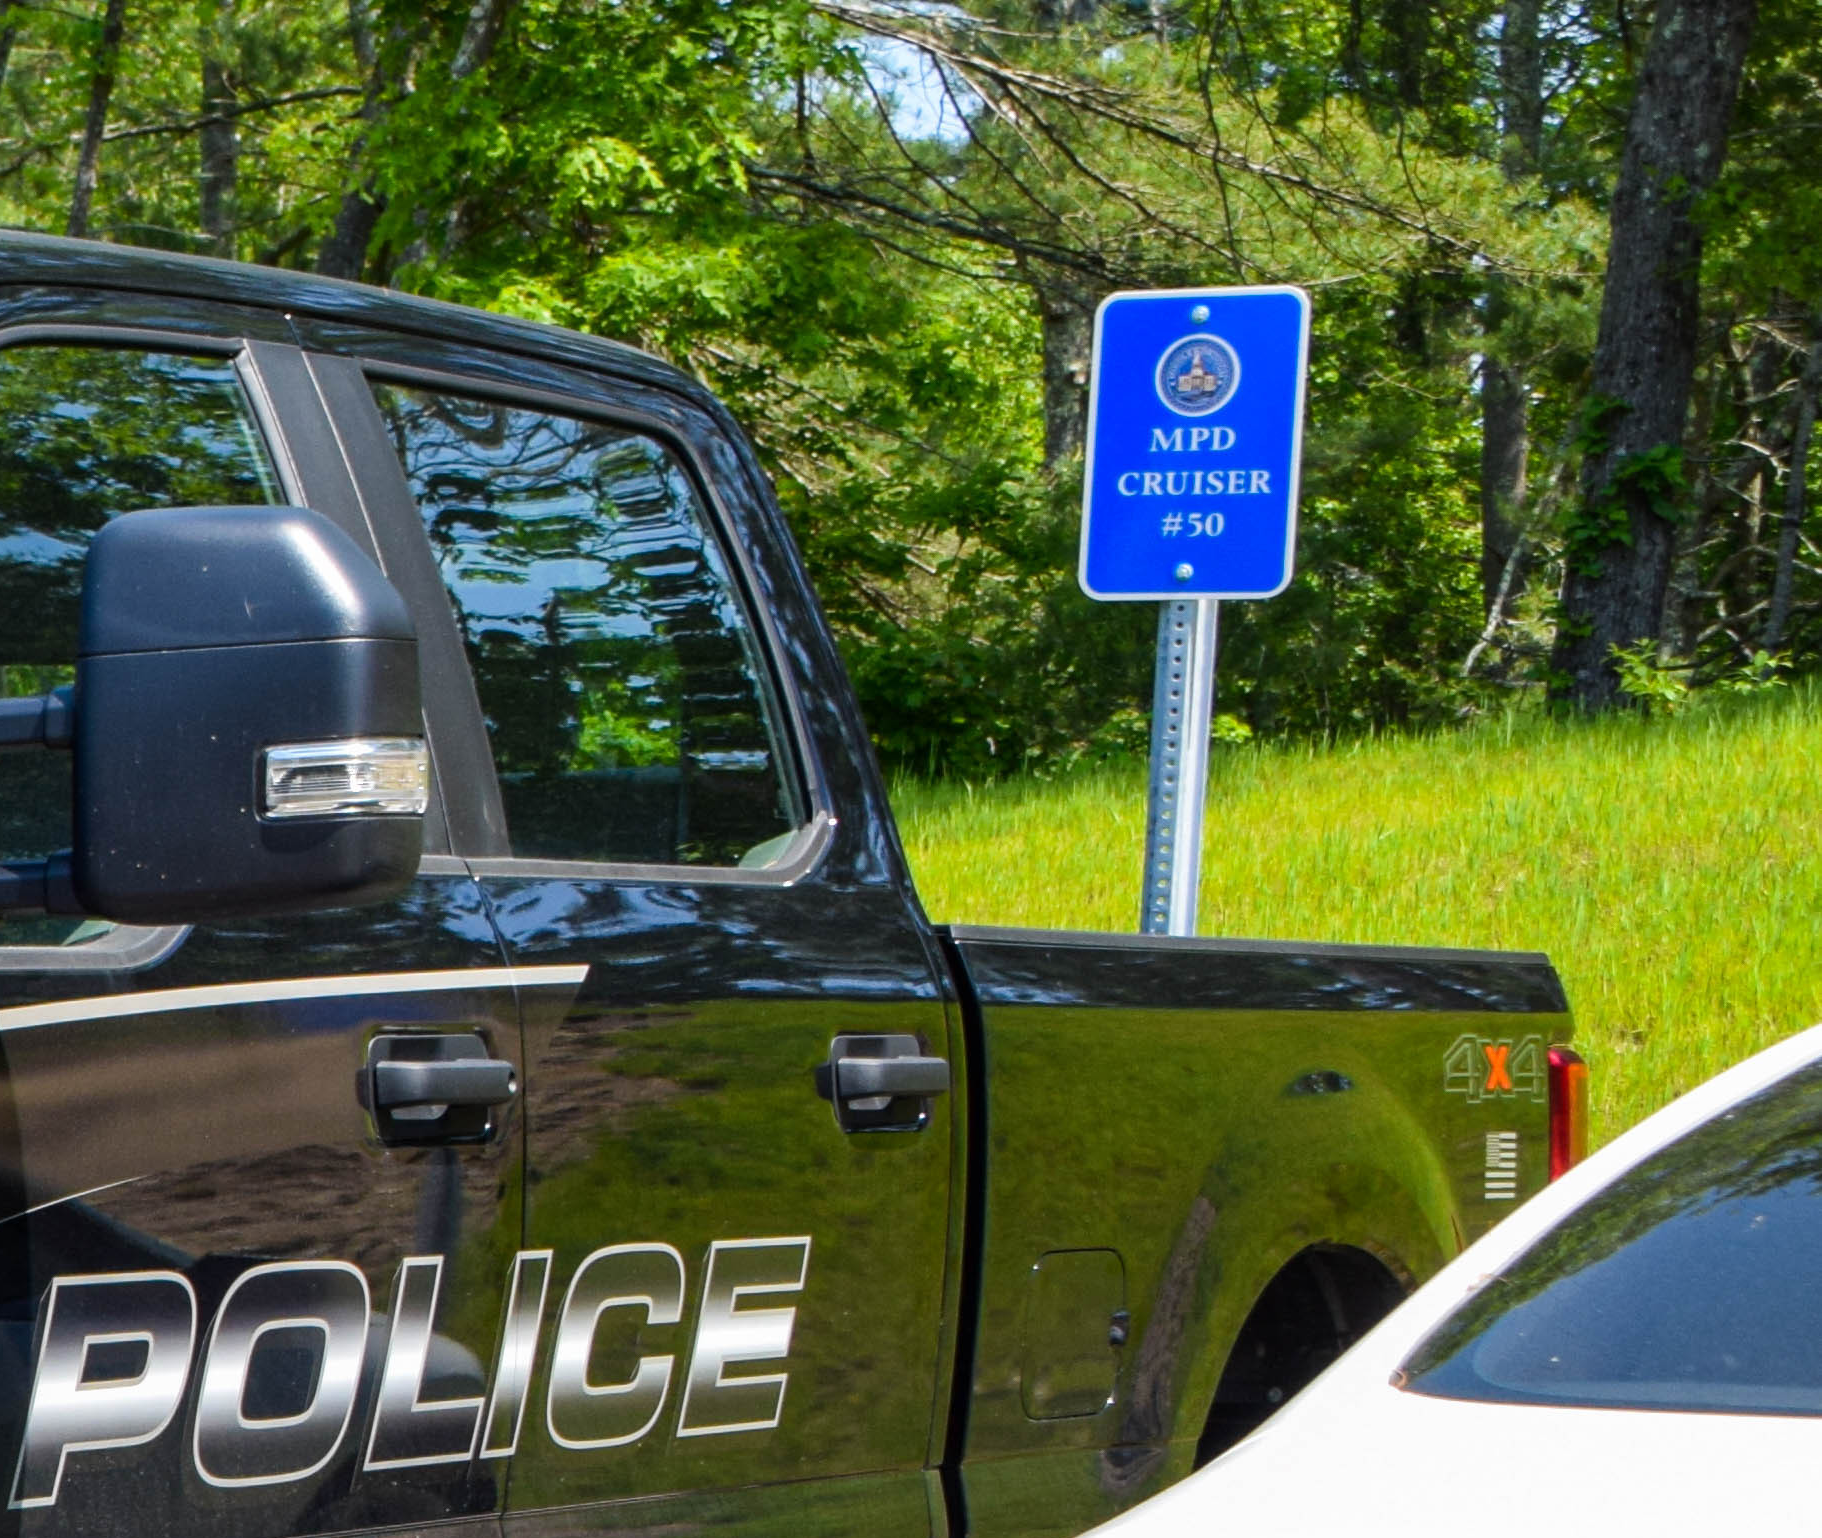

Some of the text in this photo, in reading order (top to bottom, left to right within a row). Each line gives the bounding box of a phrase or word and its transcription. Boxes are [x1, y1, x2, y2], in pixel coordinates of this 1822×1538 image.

[1149, 426, 1237, 452] MPD
[1117, 470, 1271, 496] CRUISER
[1161, 512, 1225, 538] #50
[9, 1235, 813, 1511] POLICE
